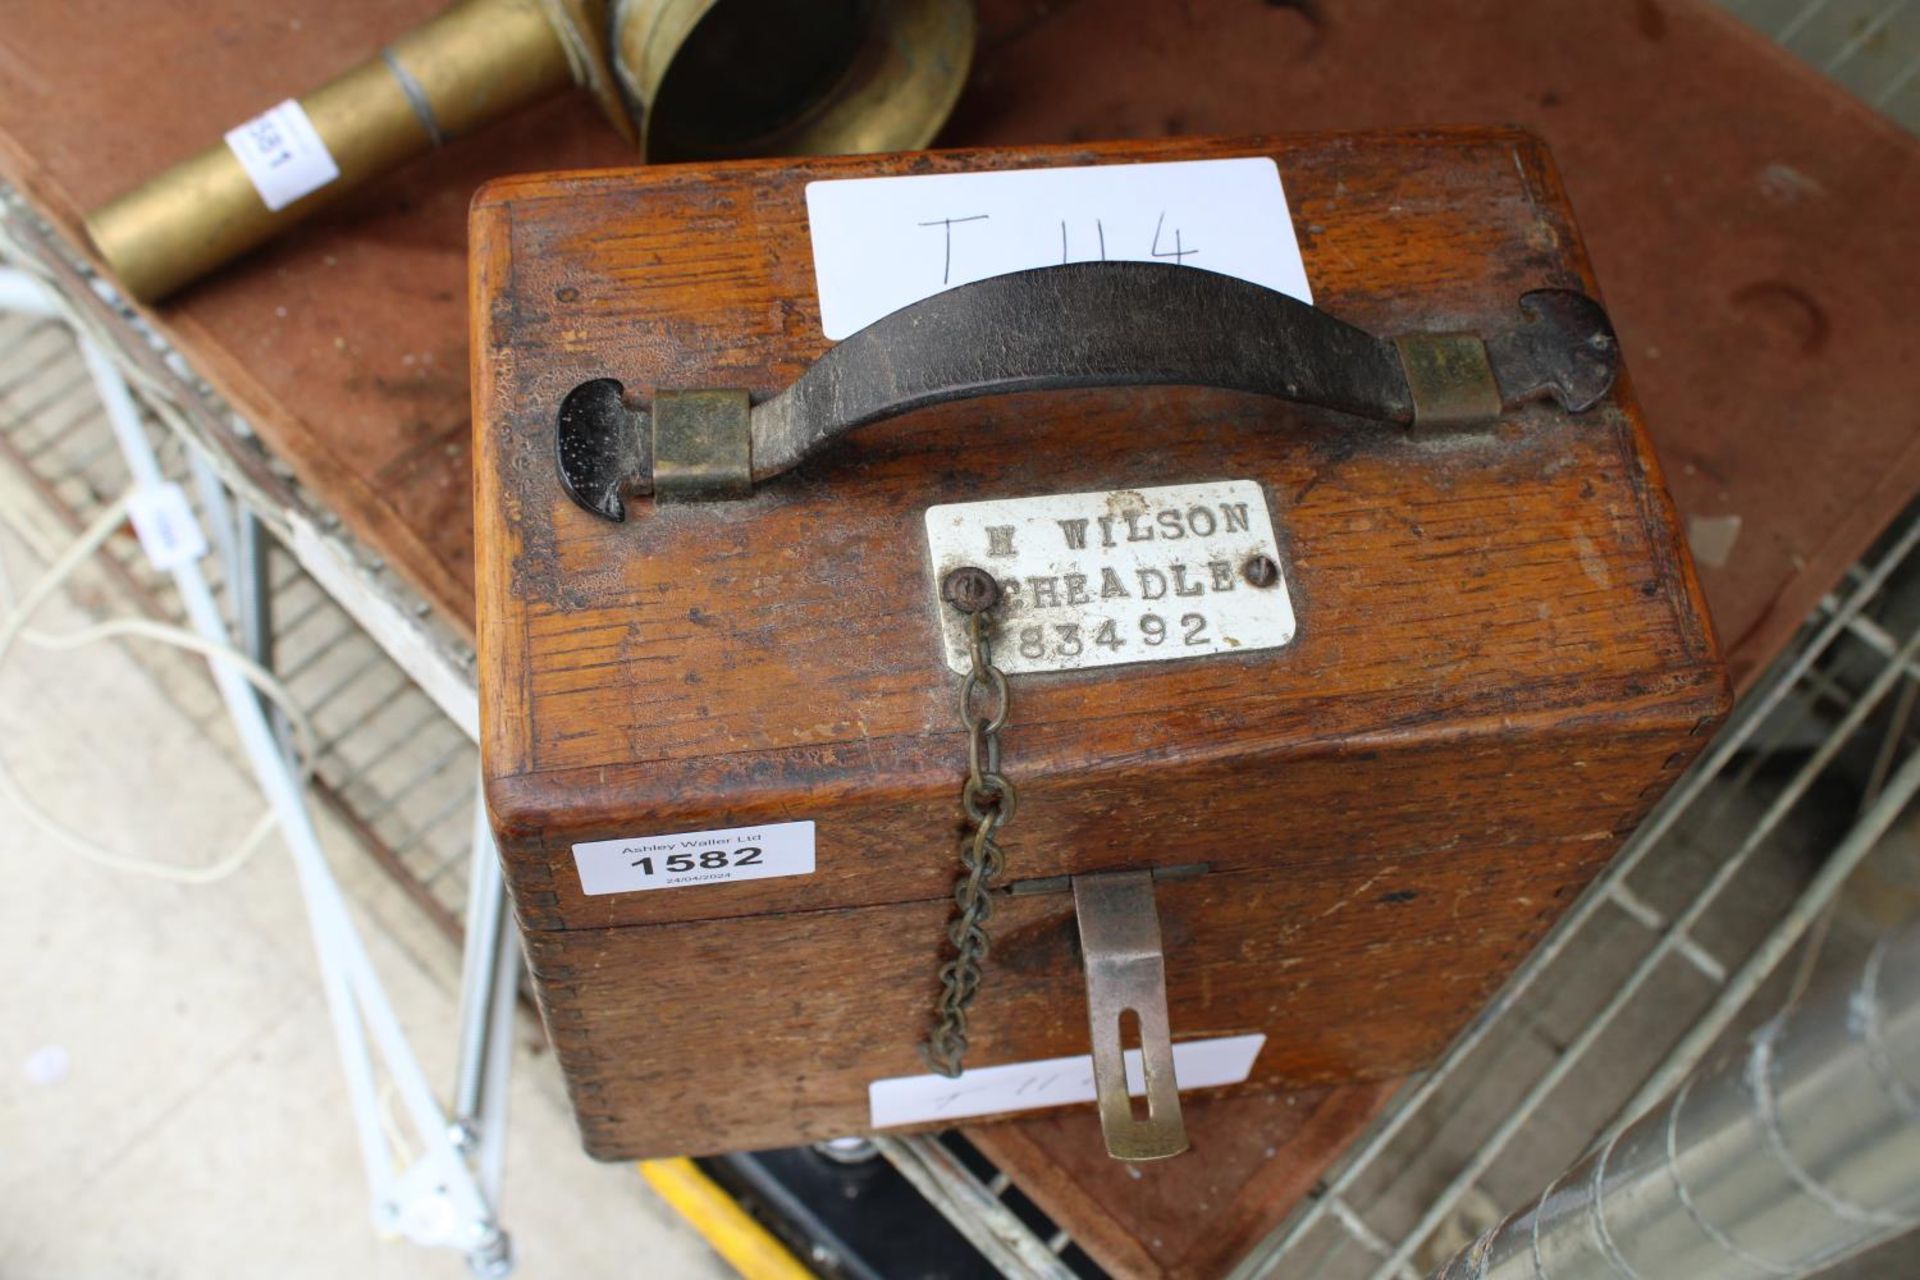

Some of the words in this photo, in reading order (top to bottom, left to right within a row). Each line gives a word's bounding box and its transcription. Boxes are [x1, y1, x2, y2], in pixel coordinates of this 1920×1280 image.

[917, 214, 990, 285] T
[1060, 210, 1200, 265] 114
[1057, 502, 1250, 551] WILSON
[1018, 612, 1211, 660] 83492
[621, 842, 677, 855] Ashley
[680, 837, 730, 848] Waller
[737, 833, 762, 844] Ltd
[631, 846, 763, 876] 1582
[666, 872, 731, 884] 24/04/2024
